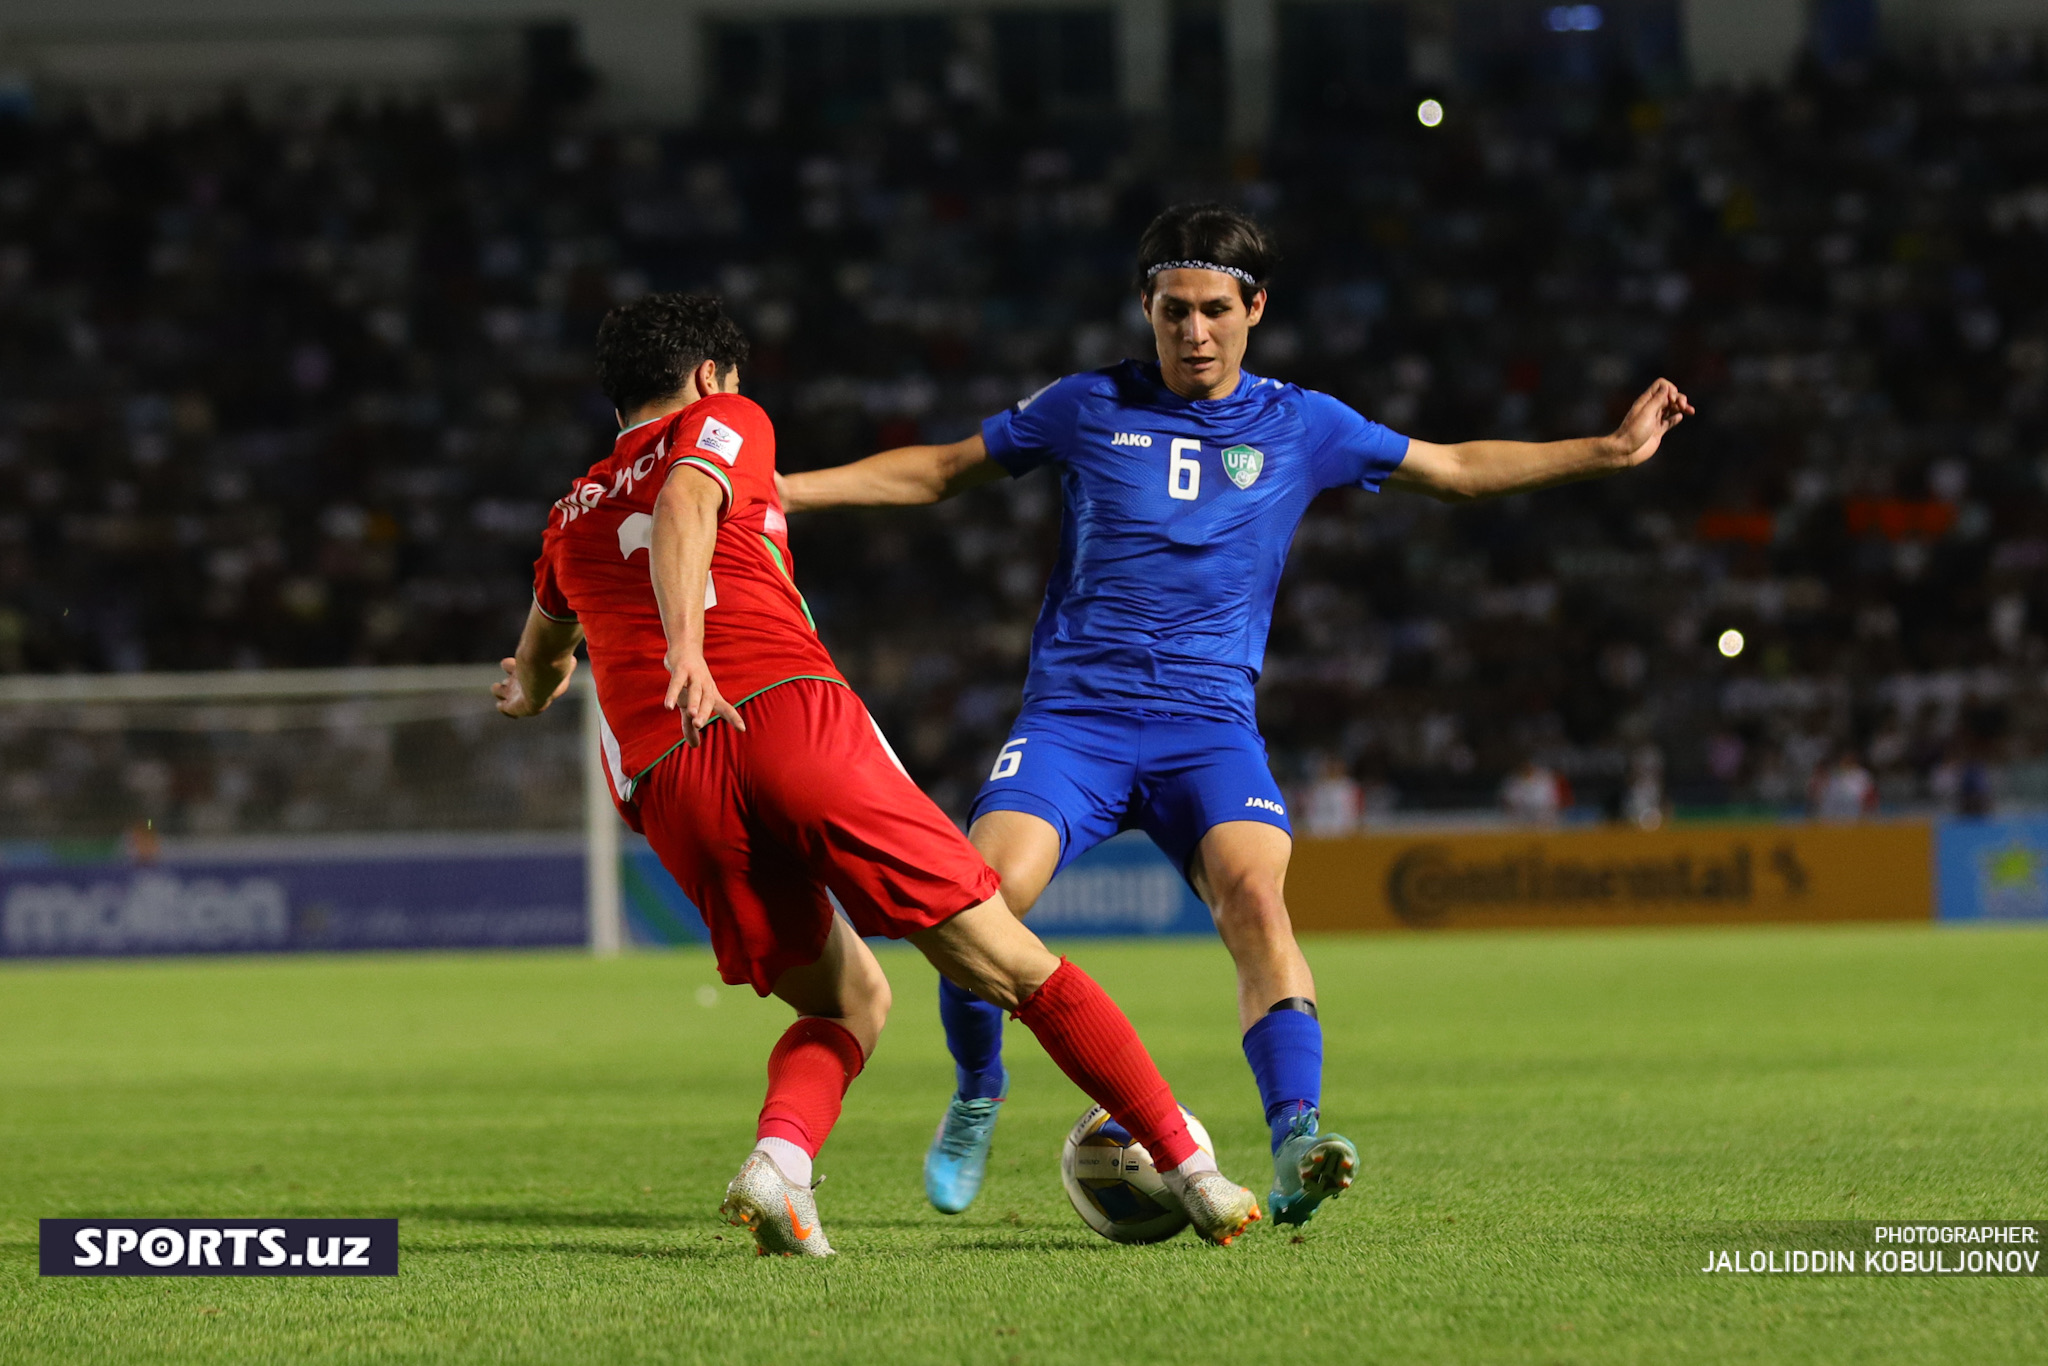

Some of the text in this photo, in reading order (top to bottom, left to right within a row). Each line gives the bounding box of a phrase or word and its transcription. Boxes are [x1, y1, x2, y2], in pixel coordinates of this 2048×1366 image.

[1111, 432, 1152, 448] JAKO
[1168, 437, 1202, 501] 6
[1228, 453, 1258, 471] UFA
[989, 738, 1028, 782] 6
[1245, 797, 1285, 816] JAKO
